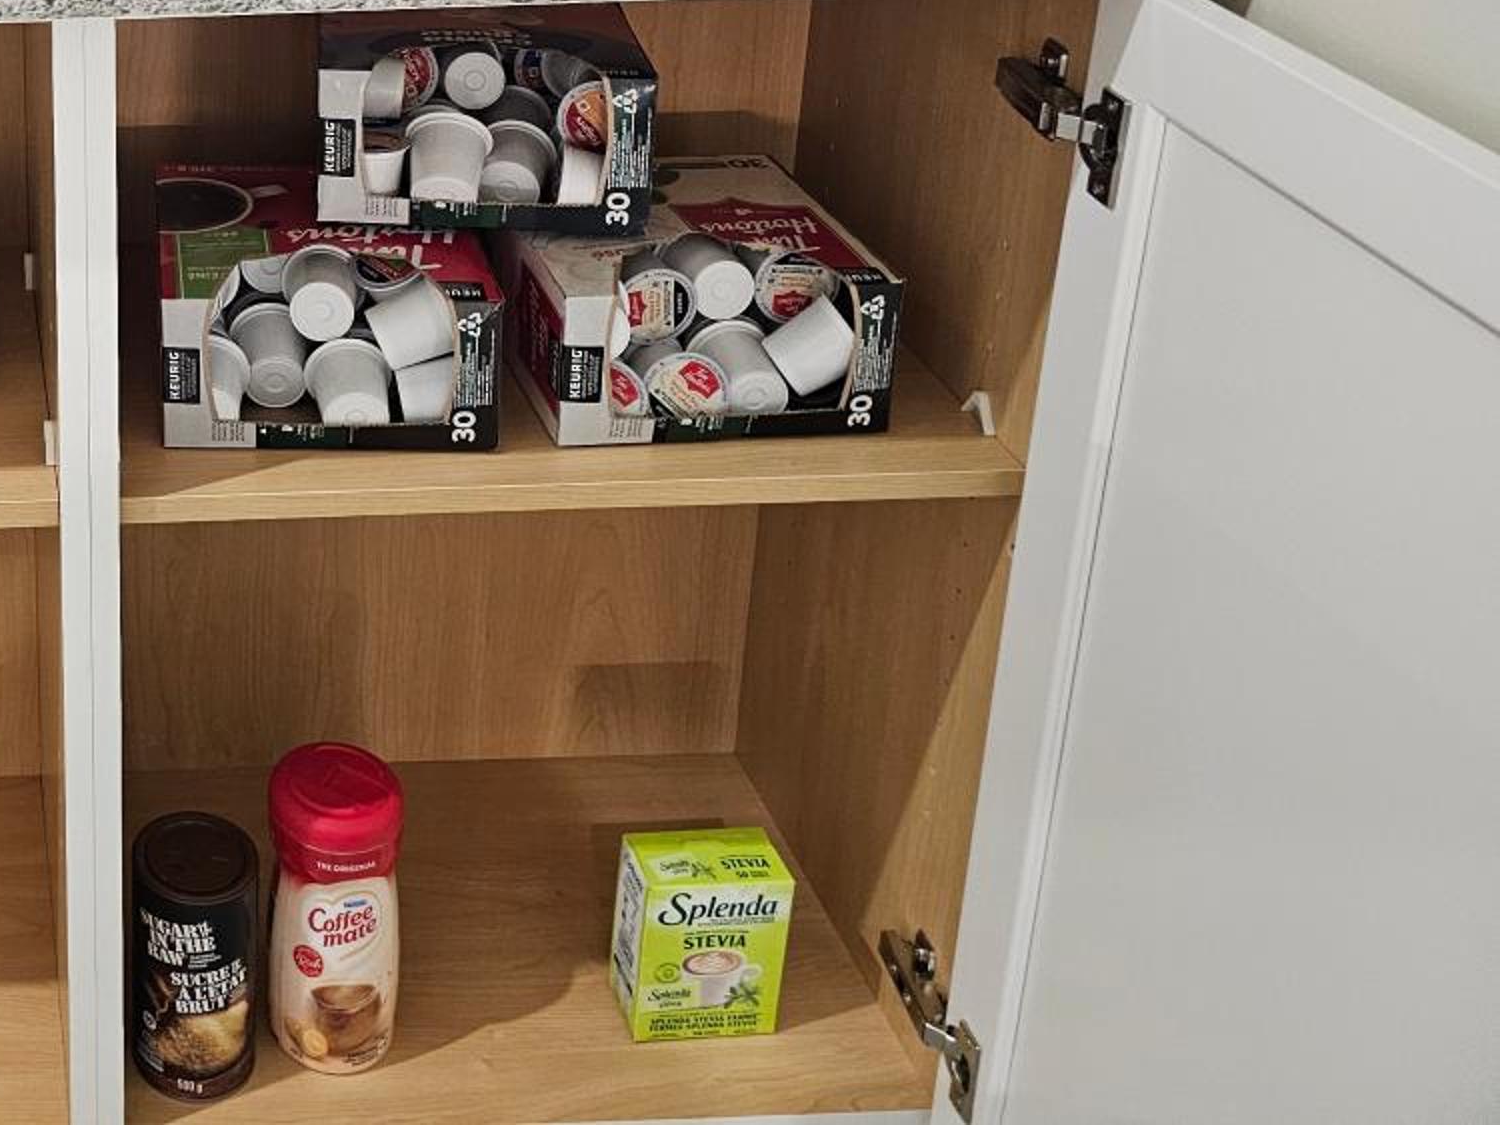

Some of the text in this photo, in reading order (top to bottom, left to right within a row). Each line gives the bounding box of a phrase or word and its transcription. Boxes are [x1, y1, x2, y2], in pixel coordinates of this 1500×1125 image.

[323, 121, 335, 173] KEURIG
[606, 192, 631, 226] 30
[168, 350, 181, 400] KEURIG
[569, 348, 583, 399] KEURIG
[452, 410, 477, 443] 30
[847, 394, 873, 427] 30
[720, 858, 771, 870] STEVIA
[308, 905, 374, 933] Coffee
[658, 892, 779, 926] Splenda
[175, 936, 217, 953] THE
[323, 918, 377, 947] mate
[683, 934, 747, 950] STEVIA
[175, 993, 227, 1014] BRUT
